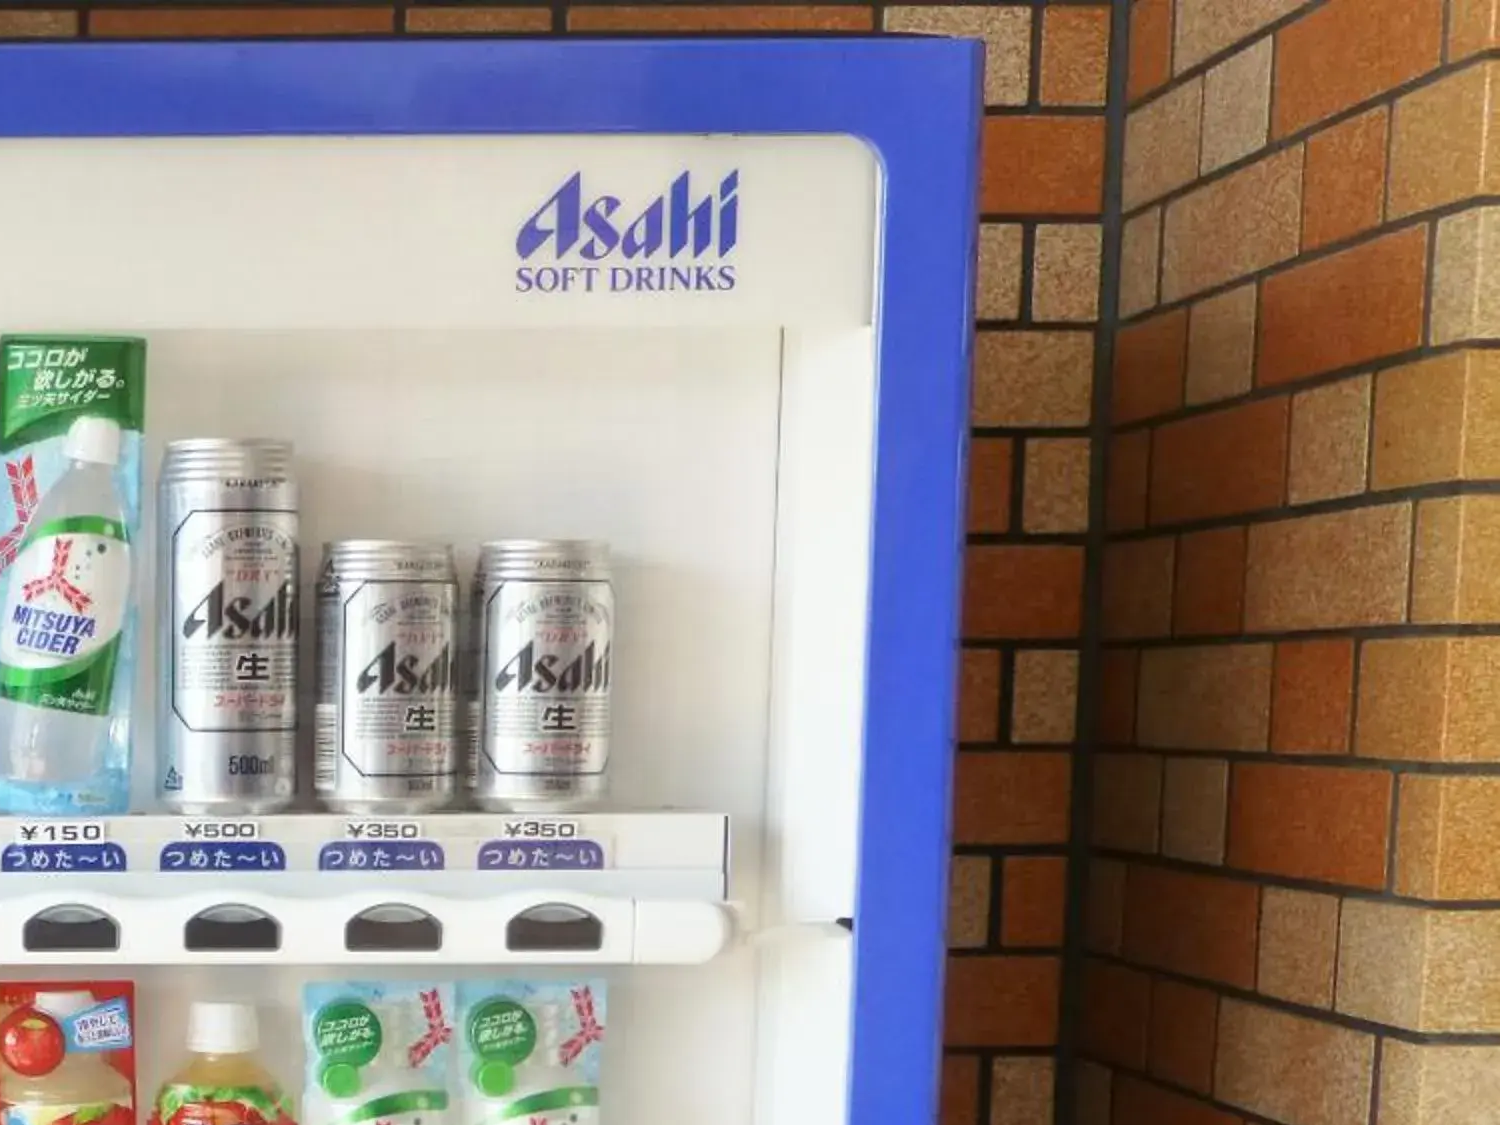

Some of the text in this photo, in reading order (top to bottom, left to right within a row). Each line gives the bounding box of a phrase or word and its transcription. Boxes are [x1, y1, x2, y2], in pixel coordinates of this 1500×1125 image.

[516, 168, 739, 260] Asahi
[515, 265, 736, 293] SOFT DRINKS
[6, 346, 89, 371] ココロが
[33, 366, 125, 391] 欲しがる。
[12, 604, 96, 640] MITSUYA
[182, 580, 298, 640] Asahi
[15, 628, 81, 656] CIDER
[235, 652, 270, 682] 生
[495, 638, 610, 694] Asahi
[405, 705, 437, 732] 生
[541, 705, 577, 732] 生
[20, 825, 101, 842] ¥150
[185, 823, 255, 838] ¥500
[347, 823, 418, 839] ¥350
[504, 822, 575, 838] ¥350
